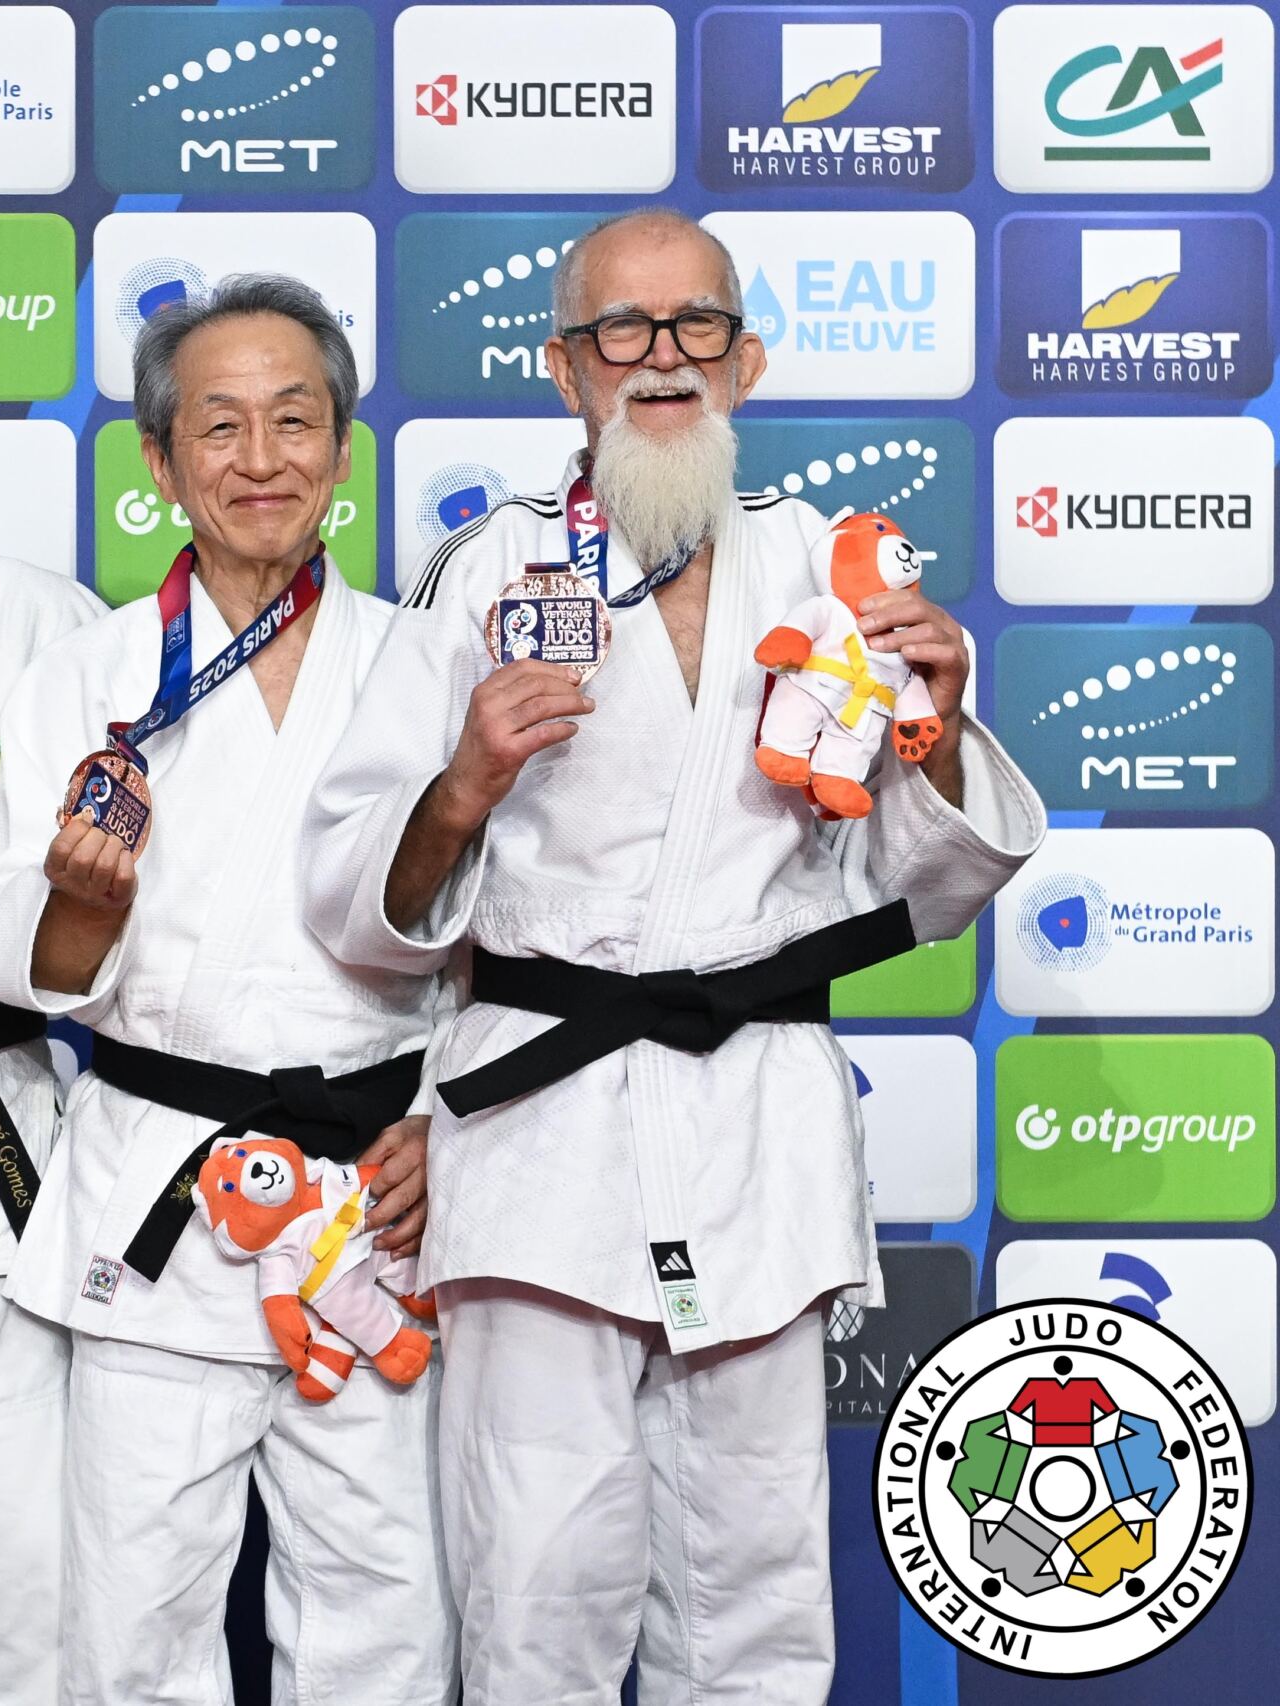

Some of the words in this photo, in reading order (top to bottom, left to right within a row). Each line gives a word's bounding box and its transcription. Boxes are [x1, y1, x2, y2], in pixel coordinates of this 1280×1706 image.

[3, 101, 53, 121] Paris
[728, 127, 941, 153] HARVEST
[181, 139, 338, 172] MET
[733, 156, 843, 176] HARVEST
[854, 156, 936, 176] GROUP
[796, 260, 936, 312] EAU
[796, 321, 936, 352] NEUVE
[1028, 332, 1240, 359] HARVEST
[1032, 362, 1143, 381] HARVEST
[1153, 362, 1235, 381] GROUP
[542, 610, 592, 619] VETERANS
[556, 601, 592, 610] WORLD
[243, 590, 295, 657] PARIS
[544, 619, 555, 629] &
[557, 618, 593, 629] KATA
[542, 630, 593, 645] JUDO
[542, 652, 569, 661] PARIS
[189, 645, 239, 702] 2025
[1081, 756, 1236, 790] MET
[113, 794, 144, 824] VETERANS
[124, 791, 146, 816] WORLD
[102, 811, 135, 845] JUDO
[117, 808, 139, 833] KATA
[1110, 902, 1221, 925] Métropole
[1114, 926, 1129, 937] du
[1133, 925, 1197, 943] Grand
[1204, 925, 1253, 943] Paris
[1070, 1106, 1256, 1152] otpgroup
